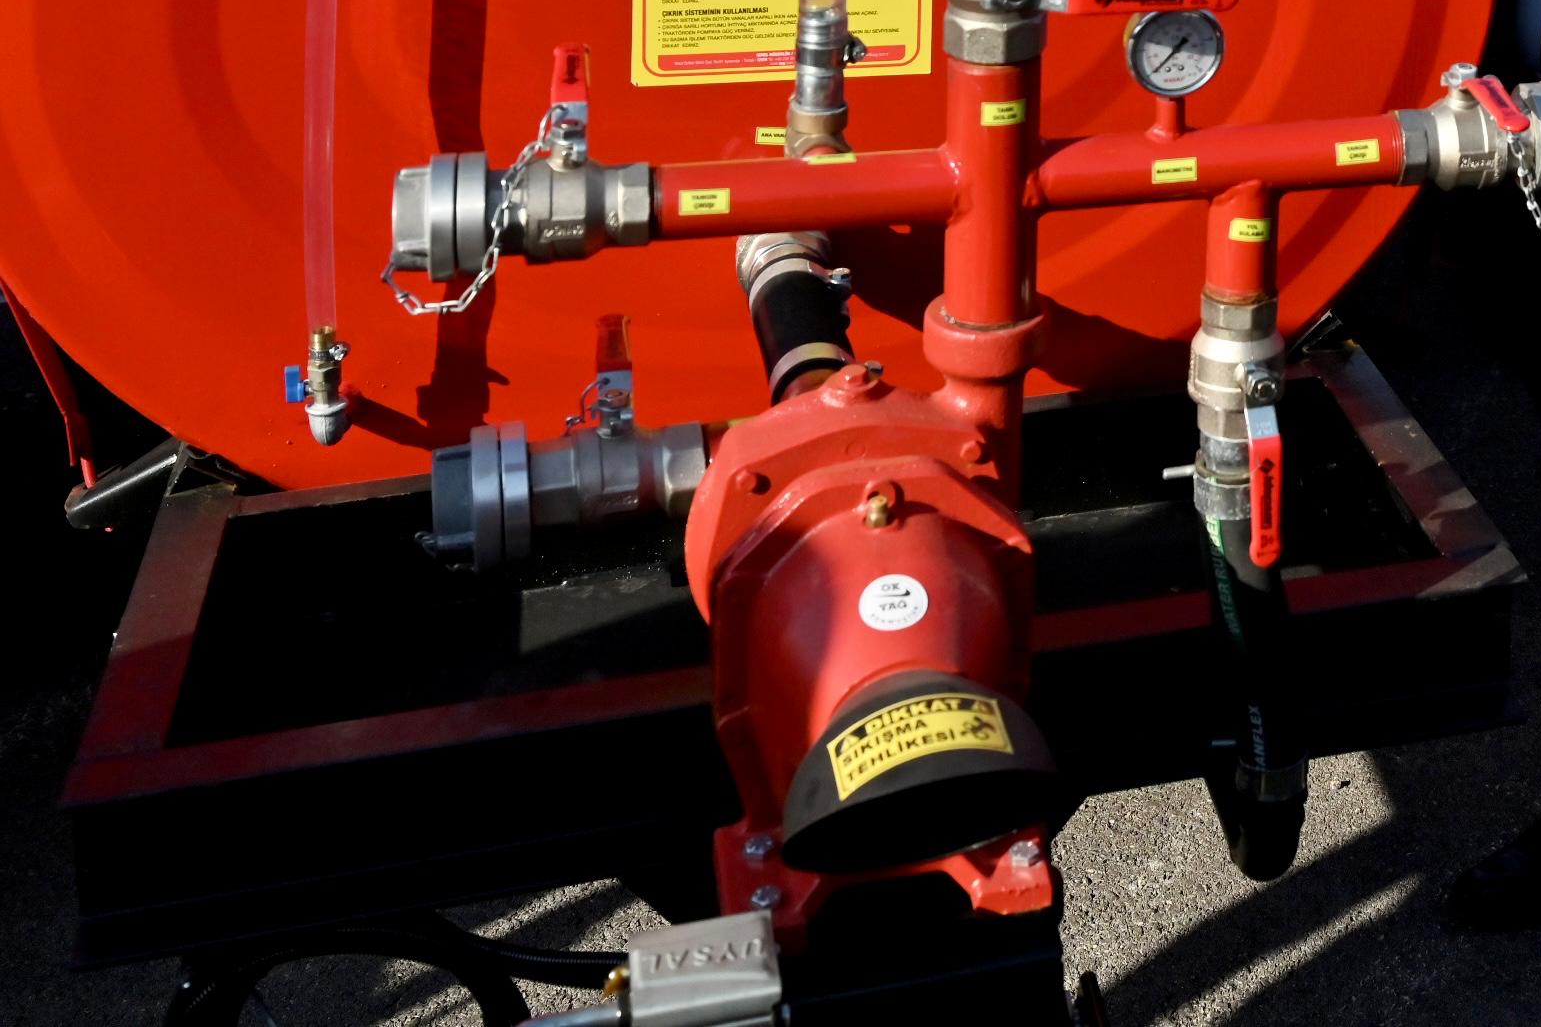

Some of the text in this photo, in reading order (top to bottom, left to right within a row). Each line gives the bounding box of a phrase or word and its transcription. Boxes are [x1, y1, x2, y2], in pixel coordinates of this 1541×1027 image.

[662, 7, 769, 18] ÇIKRIK SİSTEMİNİN KULLANILMASI
[880, 583, 900, 592] OK
[864, 698, 962, 738] DİKKAT
[842, 719, 928, 767] SIKIŞMA
[847, 729, 957, 781] TEHLİKESİ
